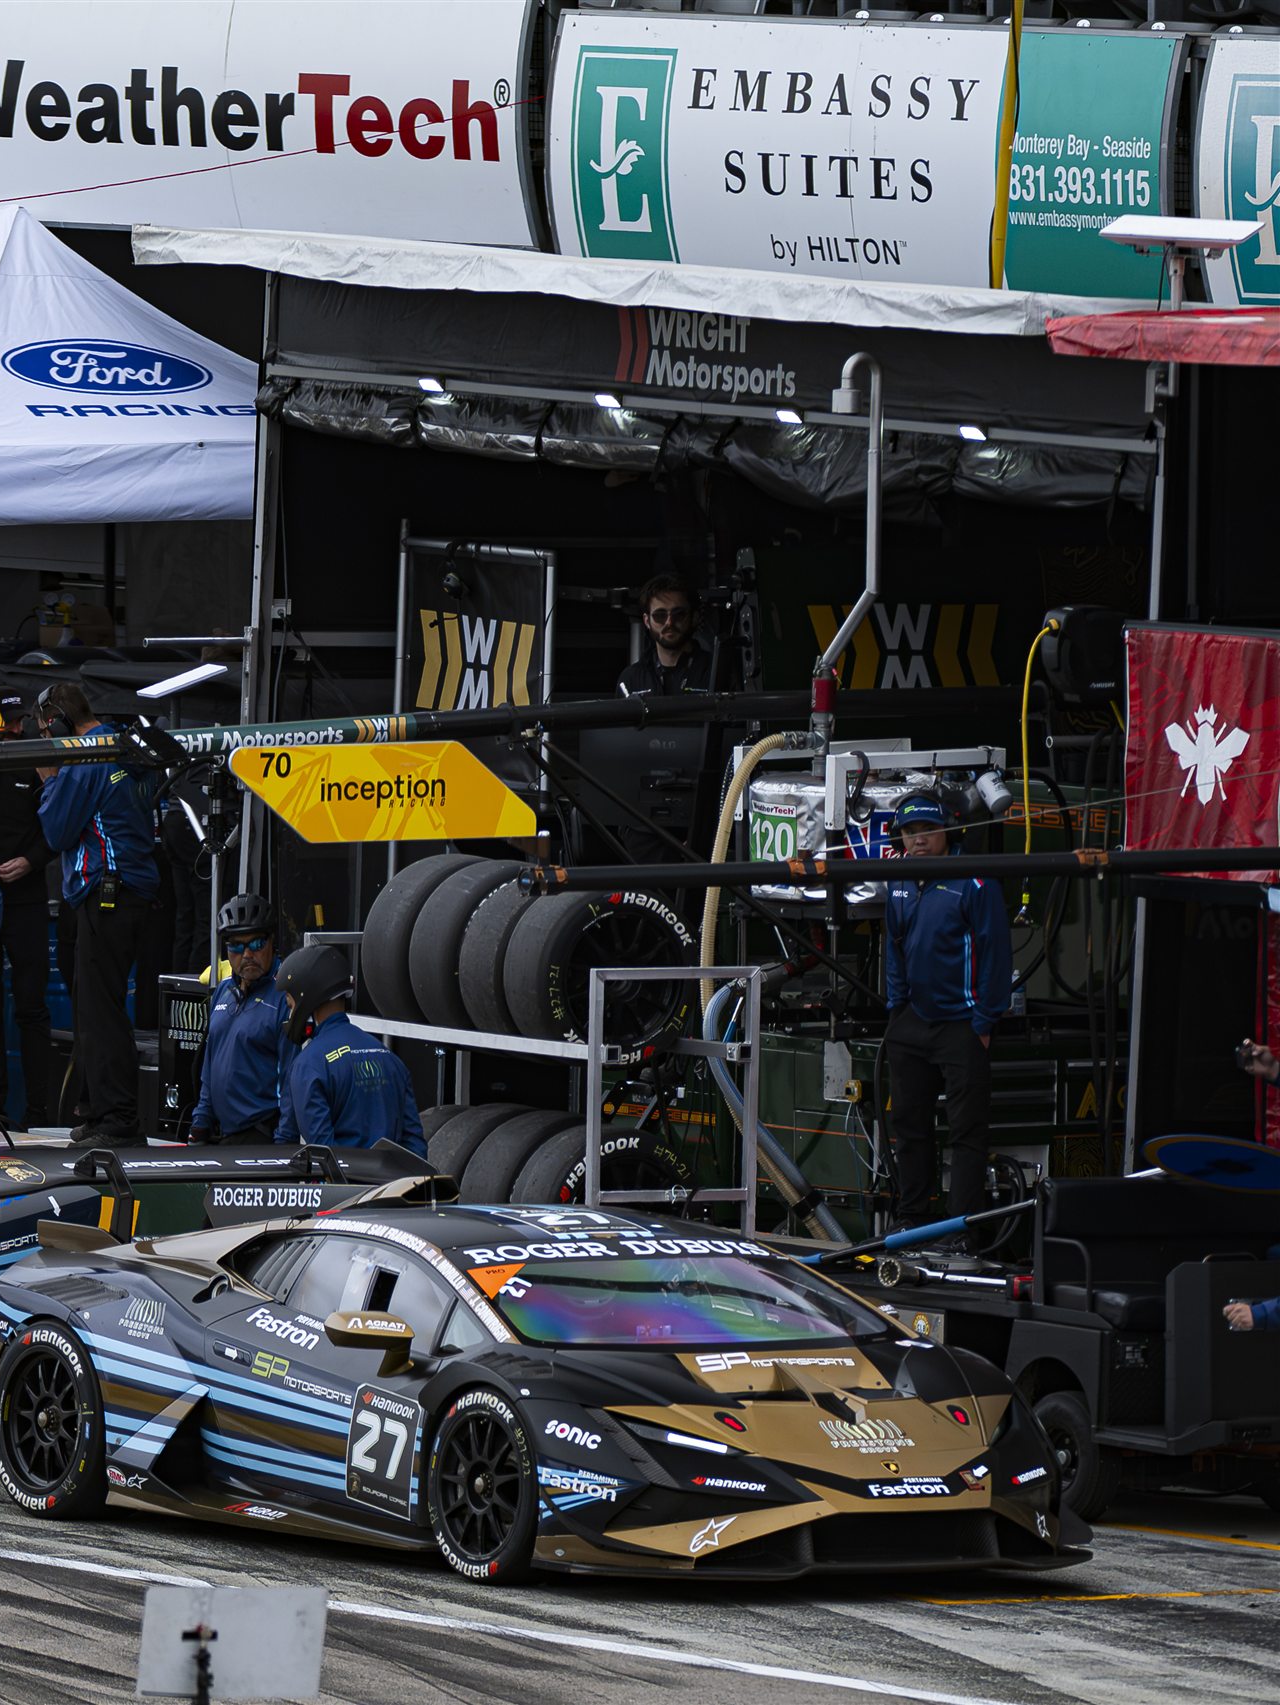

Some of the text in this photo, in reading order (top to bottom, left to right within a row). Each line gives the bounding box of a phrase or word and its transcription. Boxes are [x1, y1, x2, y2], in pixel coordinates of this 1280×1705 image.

[687, 68, 980, 122] EMBASSY
[1067, 134, 1091, 161] Bay
[1102, 135, 1151, 159] Seaside
[723, 149, 934, 203] SUITES
[1008, 164, 1151, 207] 831.393.1115
[771, 234, 901, 267] by HILTON
[648, 308, 751, 353] WRIGHT
[49, 348, 173, 386] Ford
[646, 349, 796, 403] Motorsports
[24, 404, 257, 417] RACING
[222, 727, 344, 749] Motorsports
[260, 753, 291, 778] 70
[320, 774, 446, 808] inception
[387, 798, 446, 808] RACING
[752, 817, 794, 862] 120
[168, 1028, 204, 1042] FREESTO
[325, 1045, 351, 1064] SP
[213, 1187, 322, 1208] ROGER DUBUIS
[463, 1239, 770, 1265] ROGER DUBUIS
[485, 1268, 506, 1276] PRO
[498, 1276, 533, 1299] 27
[246, 1307, 320, 1350] Fastron
[294, 1313, 326, 1333] PERTAMIN
[365, 1319, 407, 1330] AGRATI
[695, 1352, 751, 1373] SP
[252, 1351, 352, 1405] SP MOTORSPORTS
[350, 1409, 408, 1480] 27
[540, 1467, 617, 1502] Fastron
[578, 1469, 619, 1486] PERTAMINA
[869, 1482, 950, 1497] Fastron
